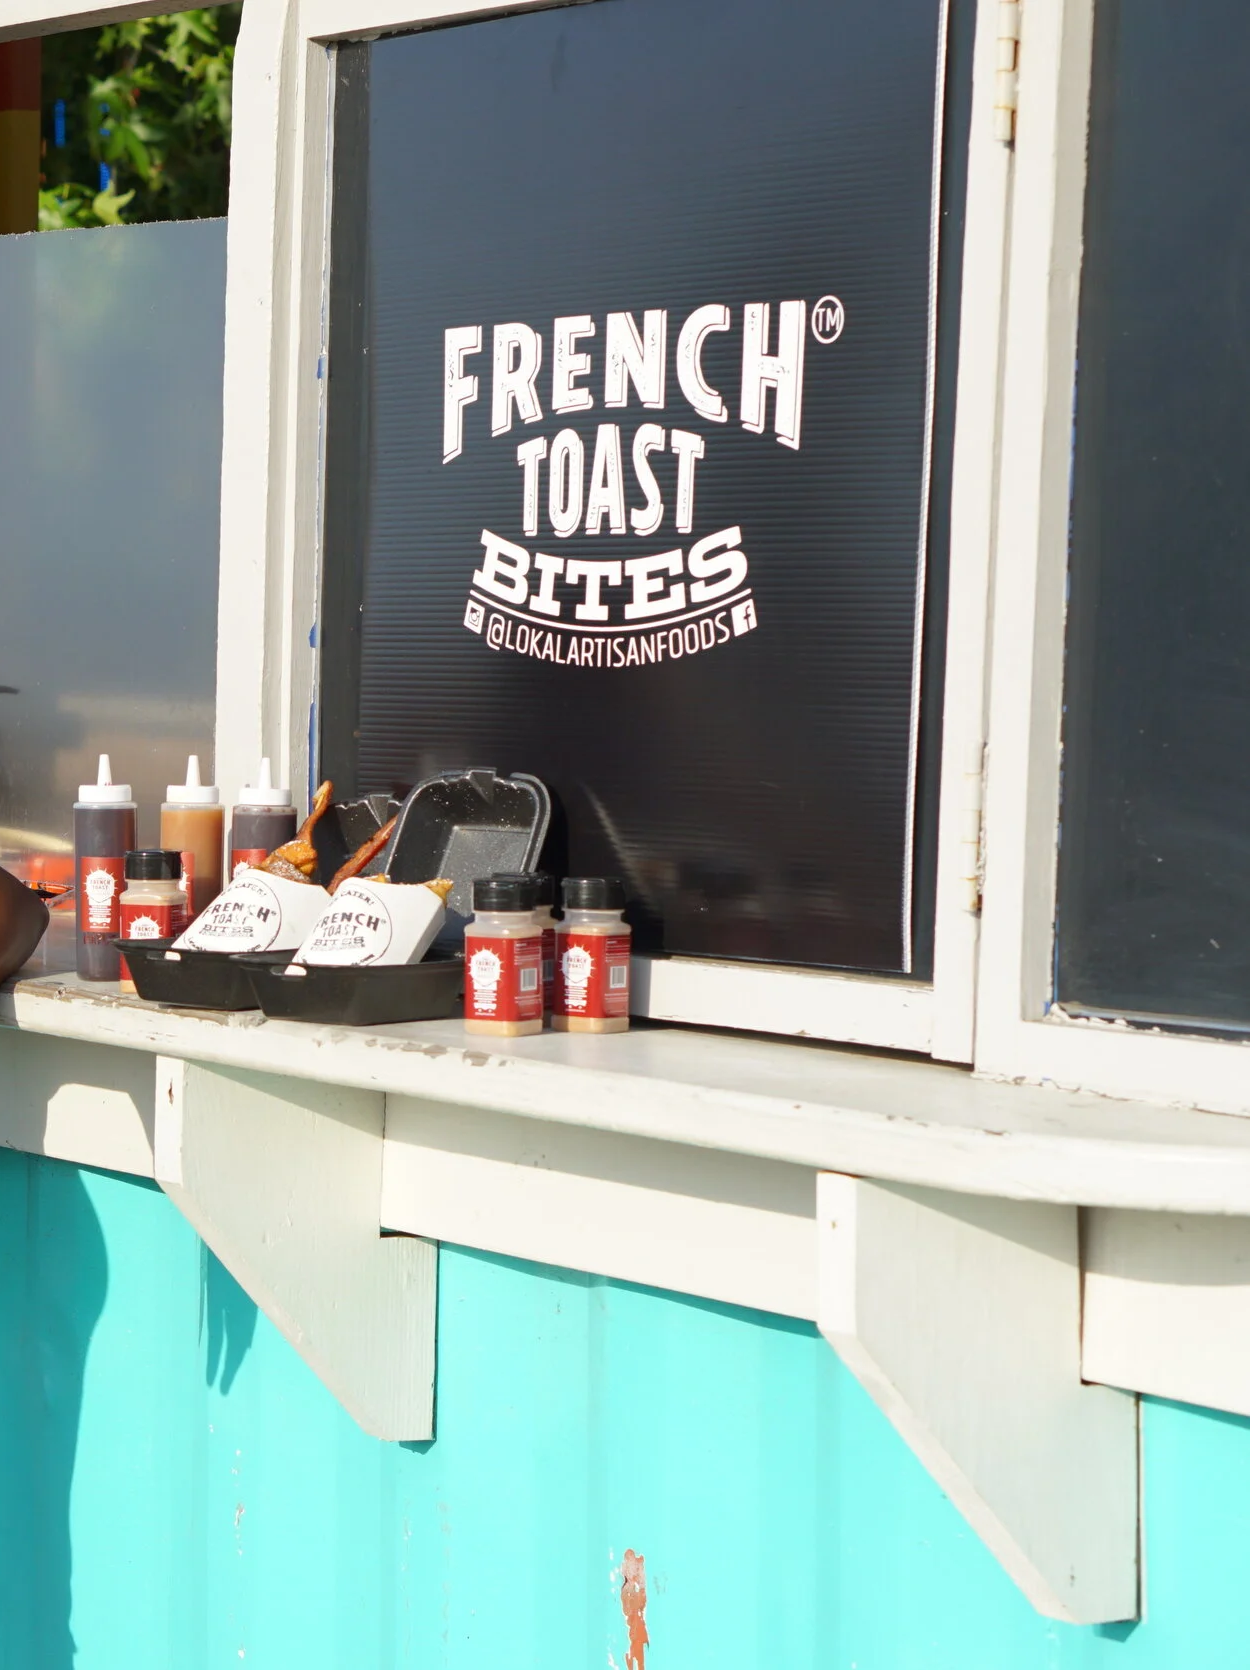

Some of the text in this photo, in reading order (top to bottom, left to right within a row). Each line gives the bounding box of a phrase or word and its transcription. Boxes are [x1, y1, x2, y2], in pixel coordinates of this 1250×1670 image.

[442, 300, 806, 465] FRENCH
[517, 423, 705, 538] TOAST
[471, 526, 748, 622] BITES
[486, 611, 730, 668] @LOKALARTISANFOODS
